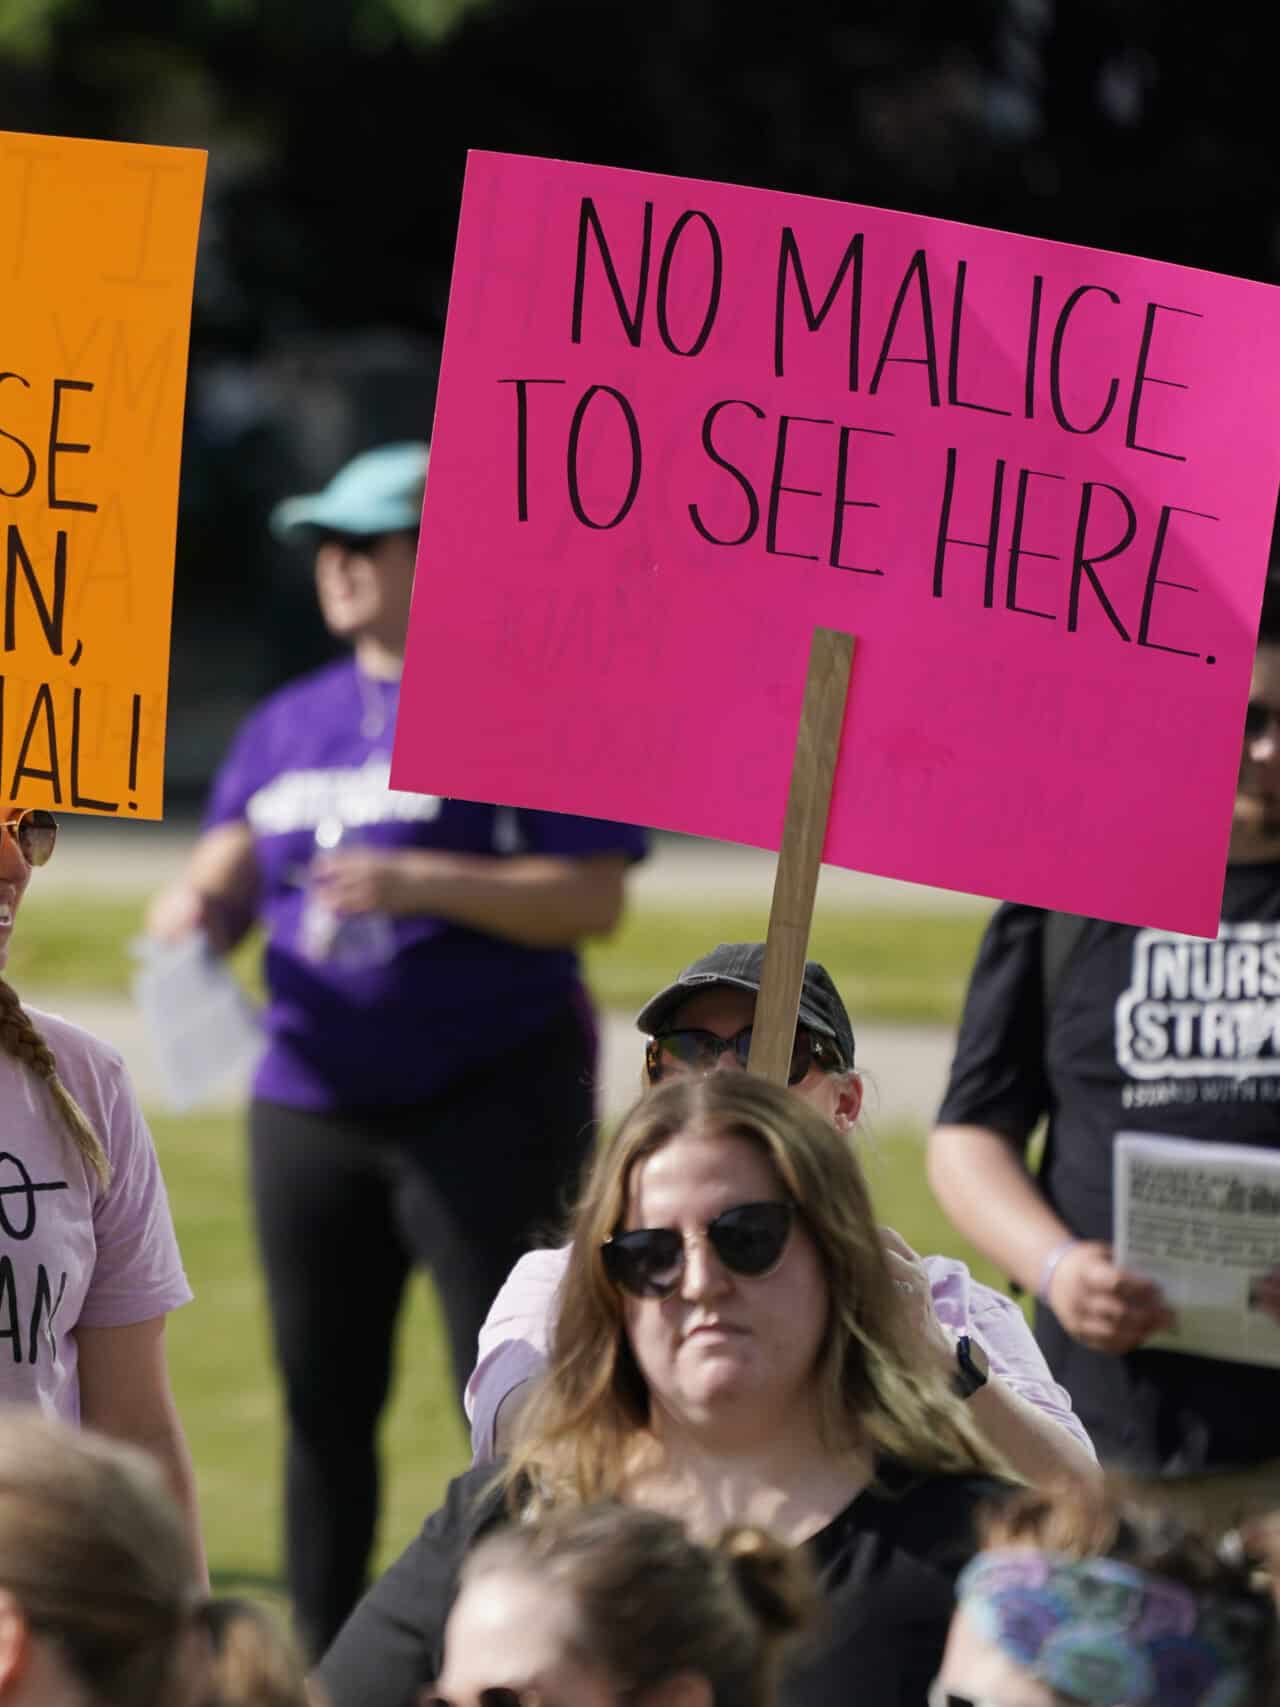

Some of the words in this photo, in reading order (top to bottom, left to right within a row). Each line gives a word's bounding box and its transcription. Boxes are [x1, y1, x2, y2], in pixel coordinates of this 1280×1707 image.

[572, 198, 722, 357] NO
[774, 227, 1204, 462] MALICE
[497, 379, 642, 530] TO
[688, 399, 895, 576] SEE
[932, 447, 1220, 665] HERE.
